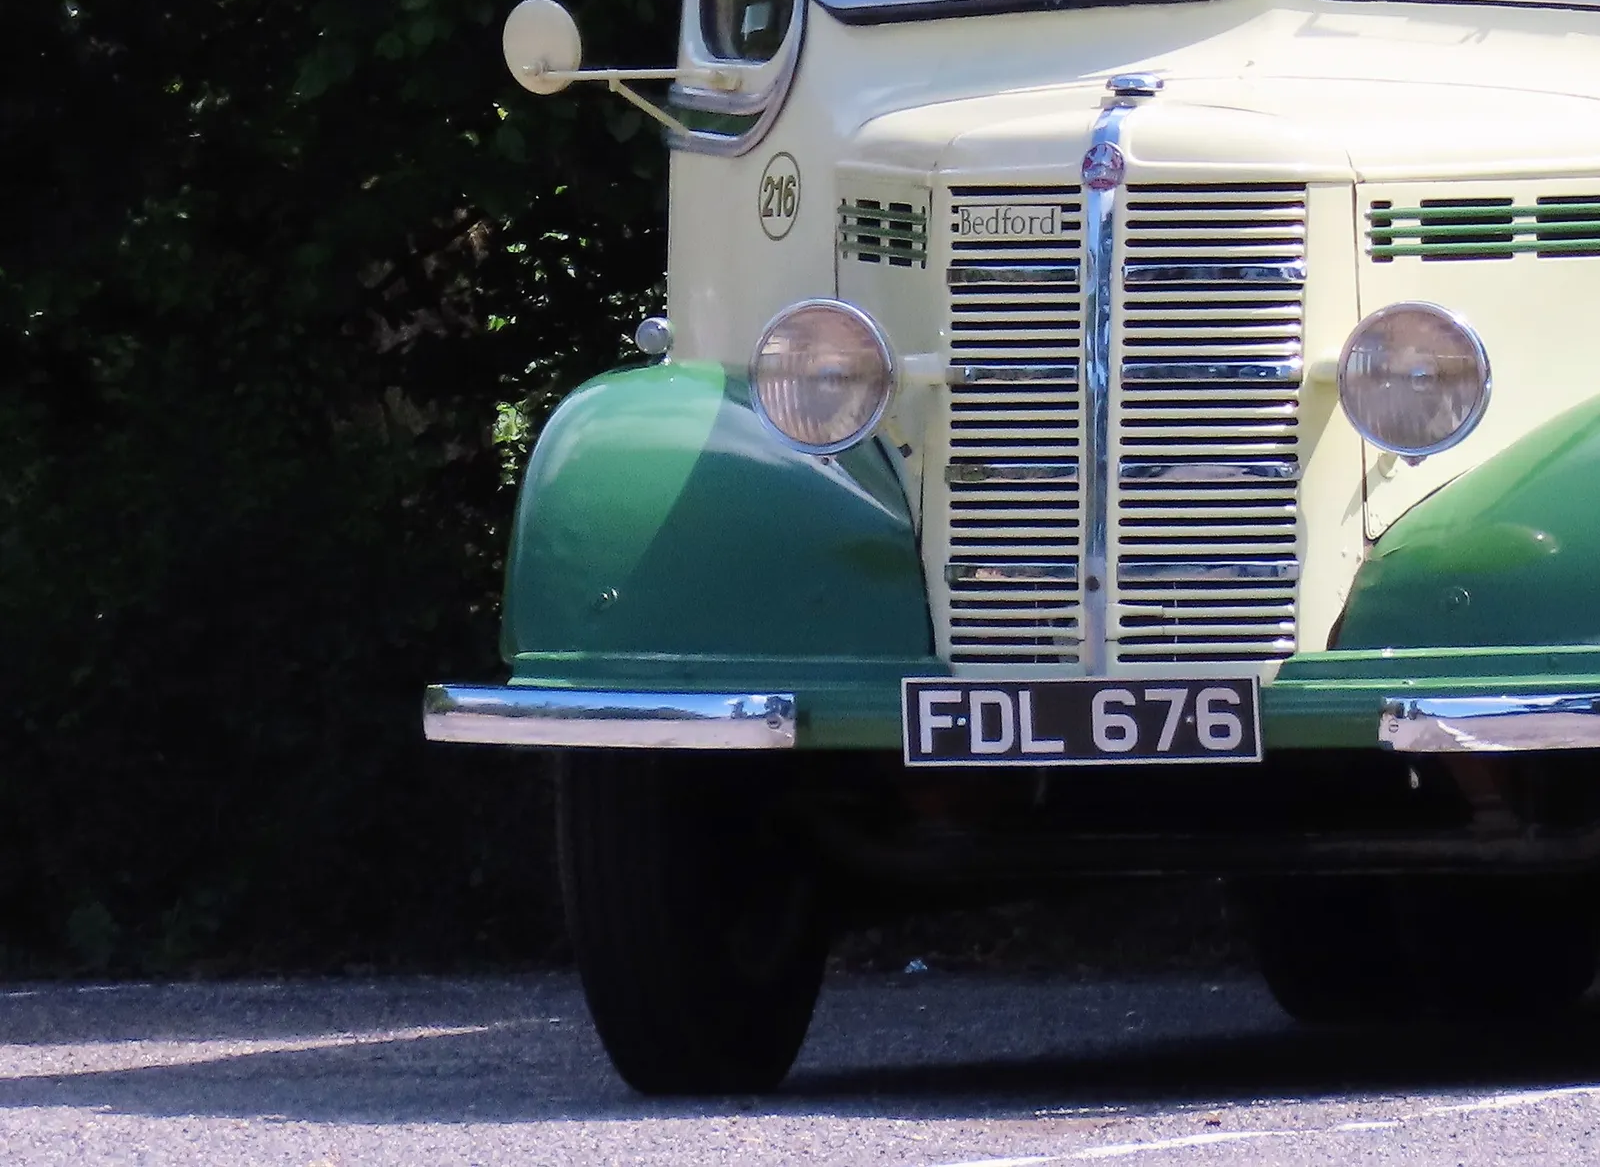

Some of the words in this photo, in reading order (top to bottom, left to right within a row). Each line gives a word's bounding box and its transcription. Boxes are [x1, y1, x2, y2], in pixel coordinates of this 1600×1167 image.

[762, 175, 796, 217] 216
[960, 207, 1056, 236] Bedford
[918, 690, 1065, 754] FDL
[1091, 687, 1242, 752] 676
